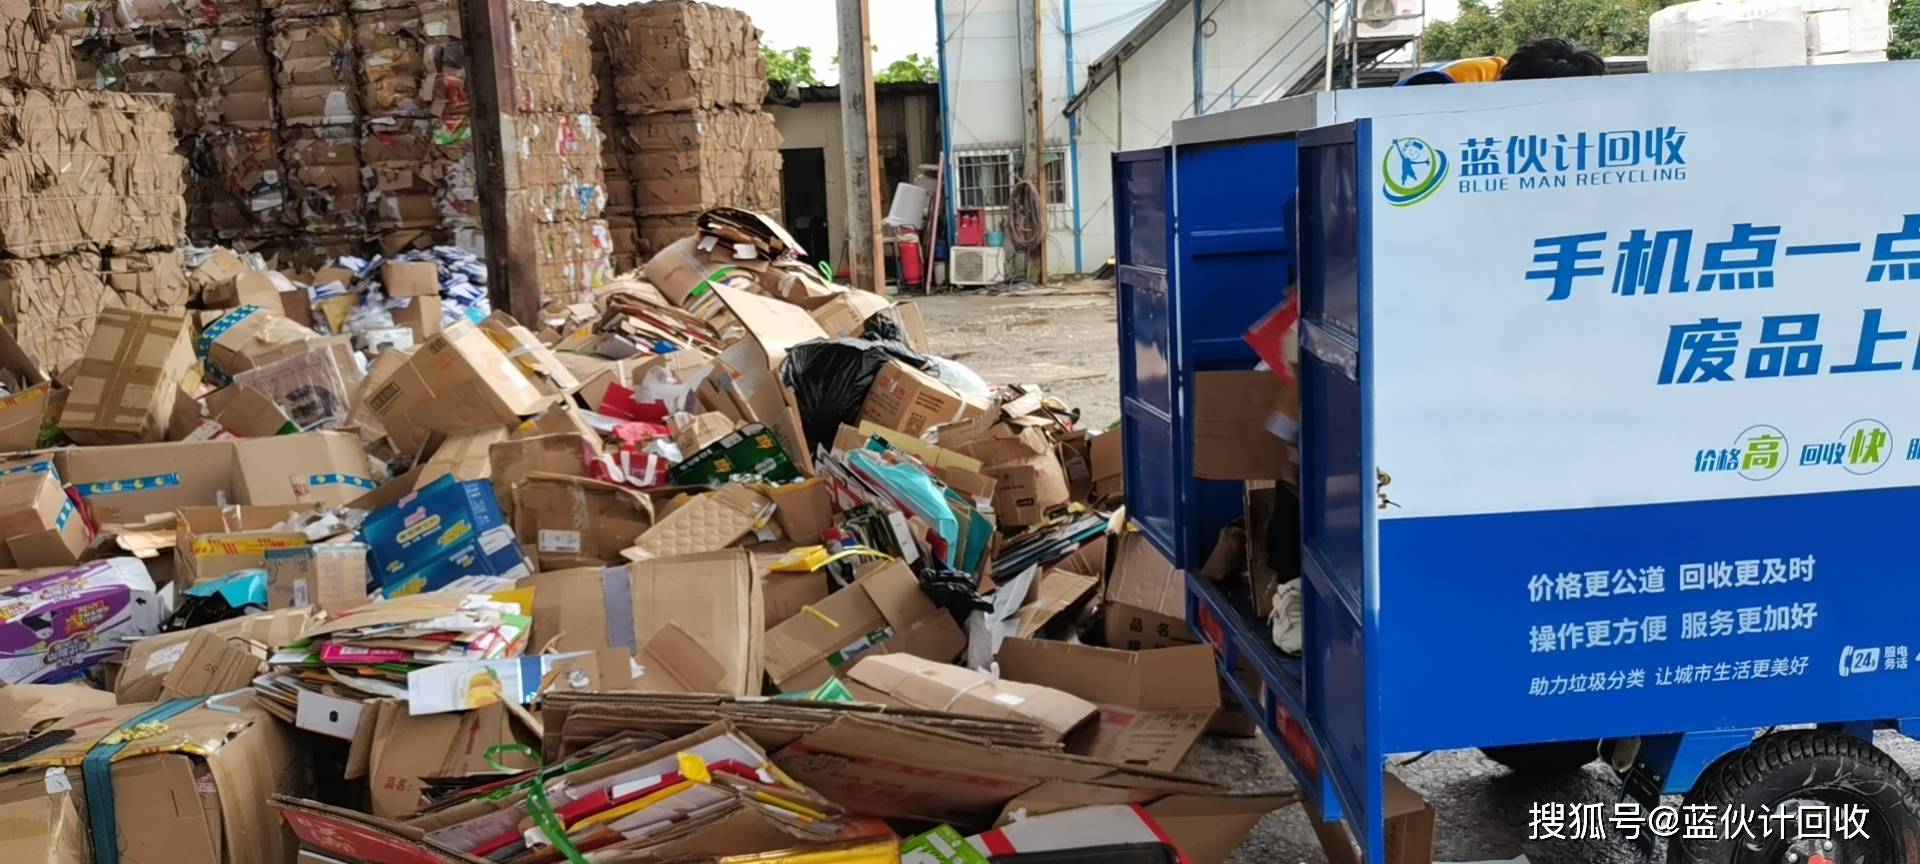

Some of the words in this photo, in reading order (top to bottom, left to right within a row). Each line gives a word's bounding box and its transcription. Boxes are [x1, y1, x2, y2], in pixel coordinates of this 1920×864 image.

[1458, 126, 1688, 176] 蓝伙计回收
[1459, 177, 1510, 194] BLUE
[1519, 174, 1566, 191] MAN
[1576, 166, 1687, 188] RECYCLING
[1657, 308, 1920, 385] 废品上
[1694, 434, 1782, 472] 价格高
[1799, 428, 1887, 466] 回收快
[1528, 566, 1666, 603] 价格更公道
[1679, 555, 1816, 592] 回收更及时
[1529, 615, 1667, 653] 操作更方便
[1681, 602, 1818, 640] 服务更加好
[1528, 668, 1646, 696] 助力垃圾分类
[1655, 656, 1810, 687] 让城市生活更美好
